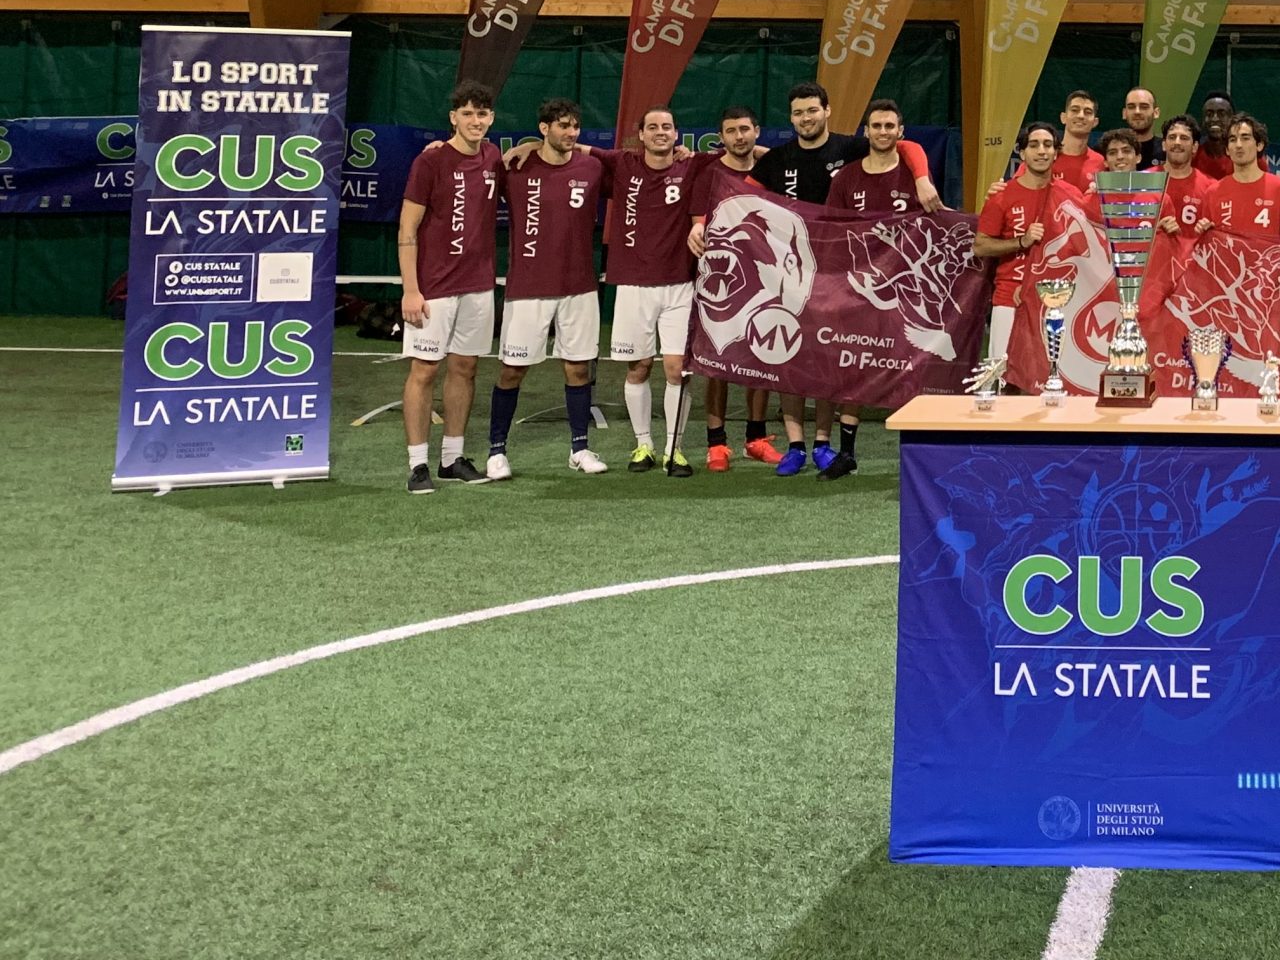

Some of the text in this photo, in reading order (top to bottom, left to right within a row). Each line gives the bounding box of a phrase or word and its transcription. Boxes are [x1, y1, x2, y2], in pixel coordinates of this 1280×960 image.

[172, 61, 318, 86] LO SPORT
[157, 89, 329, 115] IN STATALE
[155, 133, 325, 192] CUS
[484, 179, 496, 200] 7
[568, 187, 585, 209] 5
[664, 185, 681, 205] 8
[145, 209, 327, 236] LA STATALE
[449, 171, 466, 255] LA STATALE
[523, 178, 541, 258] LA STATALE
[1181, 204, 1198, 225] 6
[1254, 208, 1271, 228] 4
[625, 230, 636, 247] LA
[184, 262, 241, 271] CUS STATALE
[1013, 264, 1025, 281] LA
[180, 274, 244, 285] @CUSSTATALE
[750, 322, 801, 354] MV
[816, 326, 895, 349] CAMPIONATI
[144, 319, 315, 382] CUS
[731, 363, 780, 382] VETERINARIA
[133, 394, 317, 426] LA STATALE
[1002, 554, 1205, 637] CUS
[993, 662, 1211, 699] LA STATALE
[1096, 802, 1160, 814] UNIVERSITÀ
[1096, 815, 1164, 826] DEGLI STUDI
[1096, 826, 1155, 836] DI MILANO
